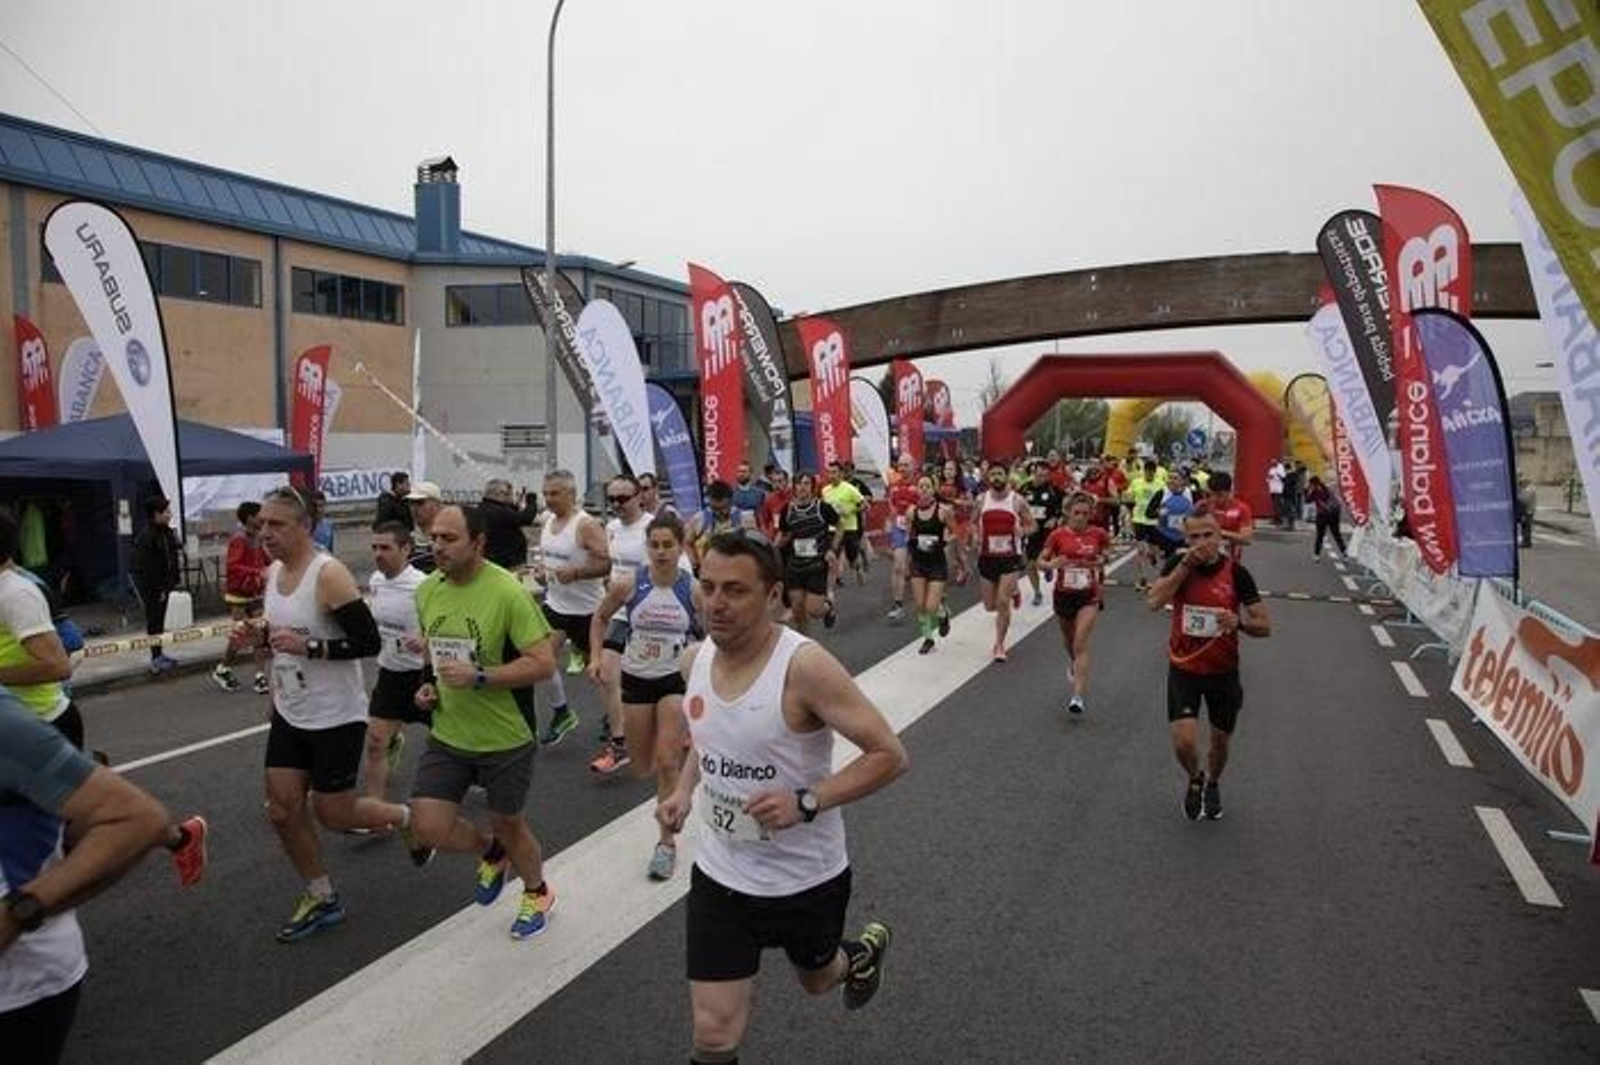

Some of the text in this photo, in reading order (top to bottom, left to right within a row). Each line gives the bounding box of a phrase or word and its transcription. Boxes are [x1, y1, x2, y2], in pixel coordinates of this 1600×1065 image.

[1460, 0, 1600, 274] EPO
[321, 472, 392, 497] ABANC
[721, 758, 777, 781] blanco
[713, 805, 735, 833] 52
